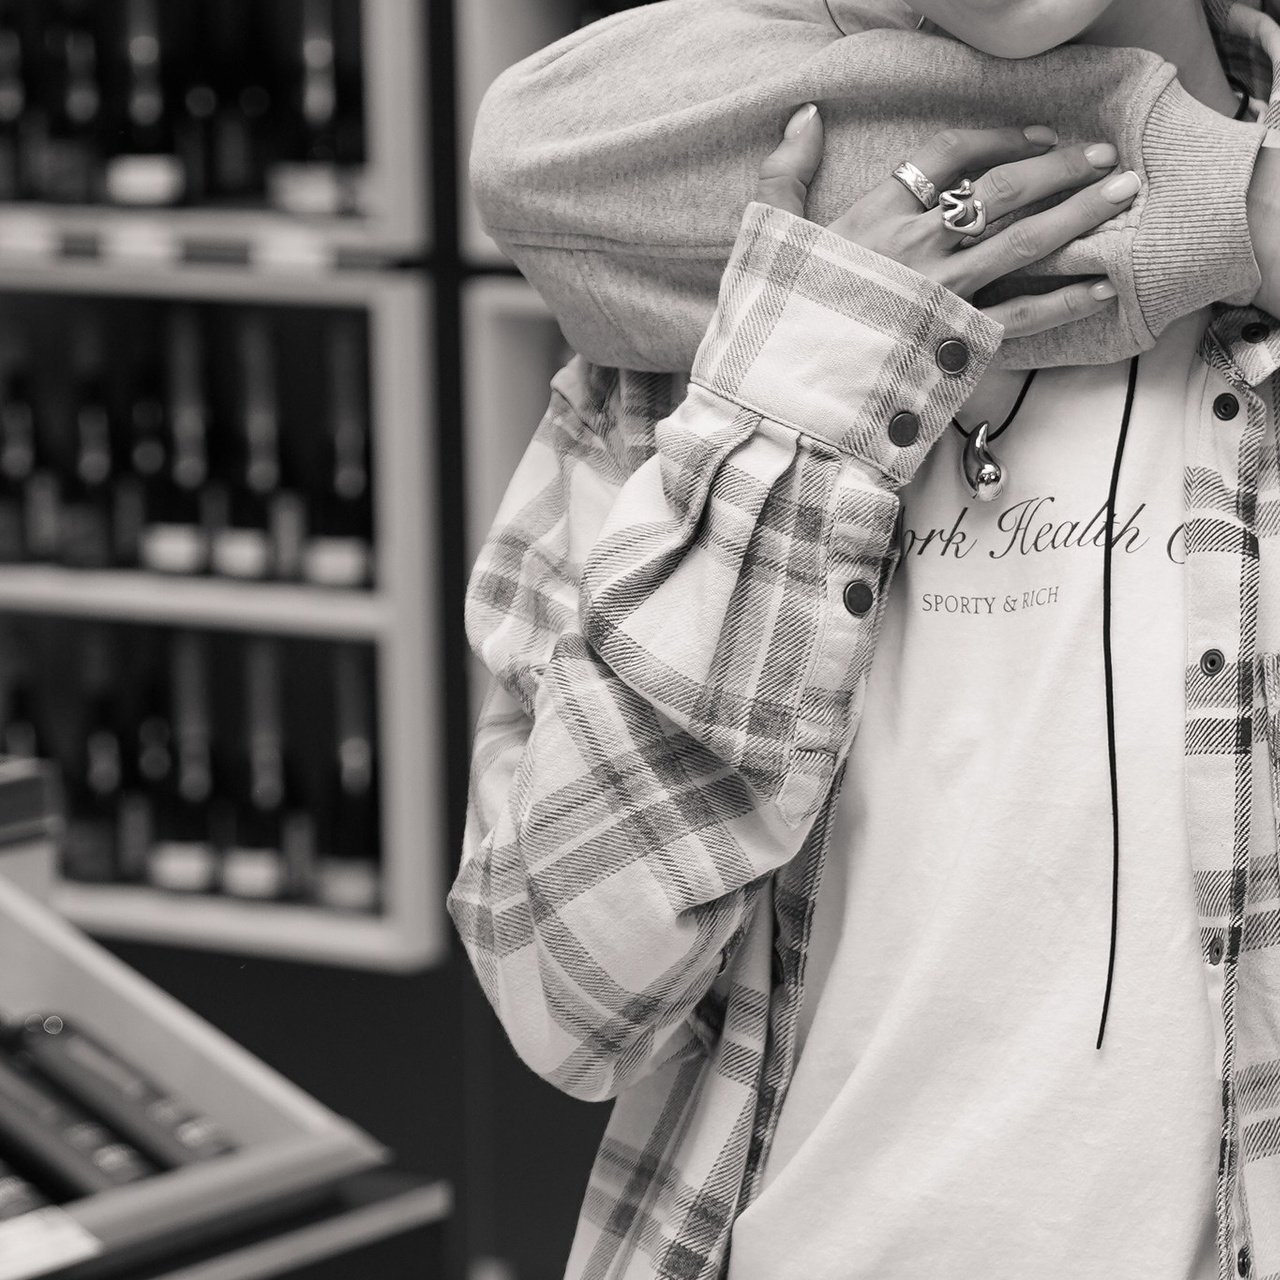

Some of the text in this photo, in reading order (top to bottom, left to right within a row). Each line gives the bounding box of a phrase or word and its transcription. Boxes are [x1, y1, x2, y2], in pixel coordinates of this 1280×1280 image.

[922, 586, 1059, 614] SPORTY & RICH
